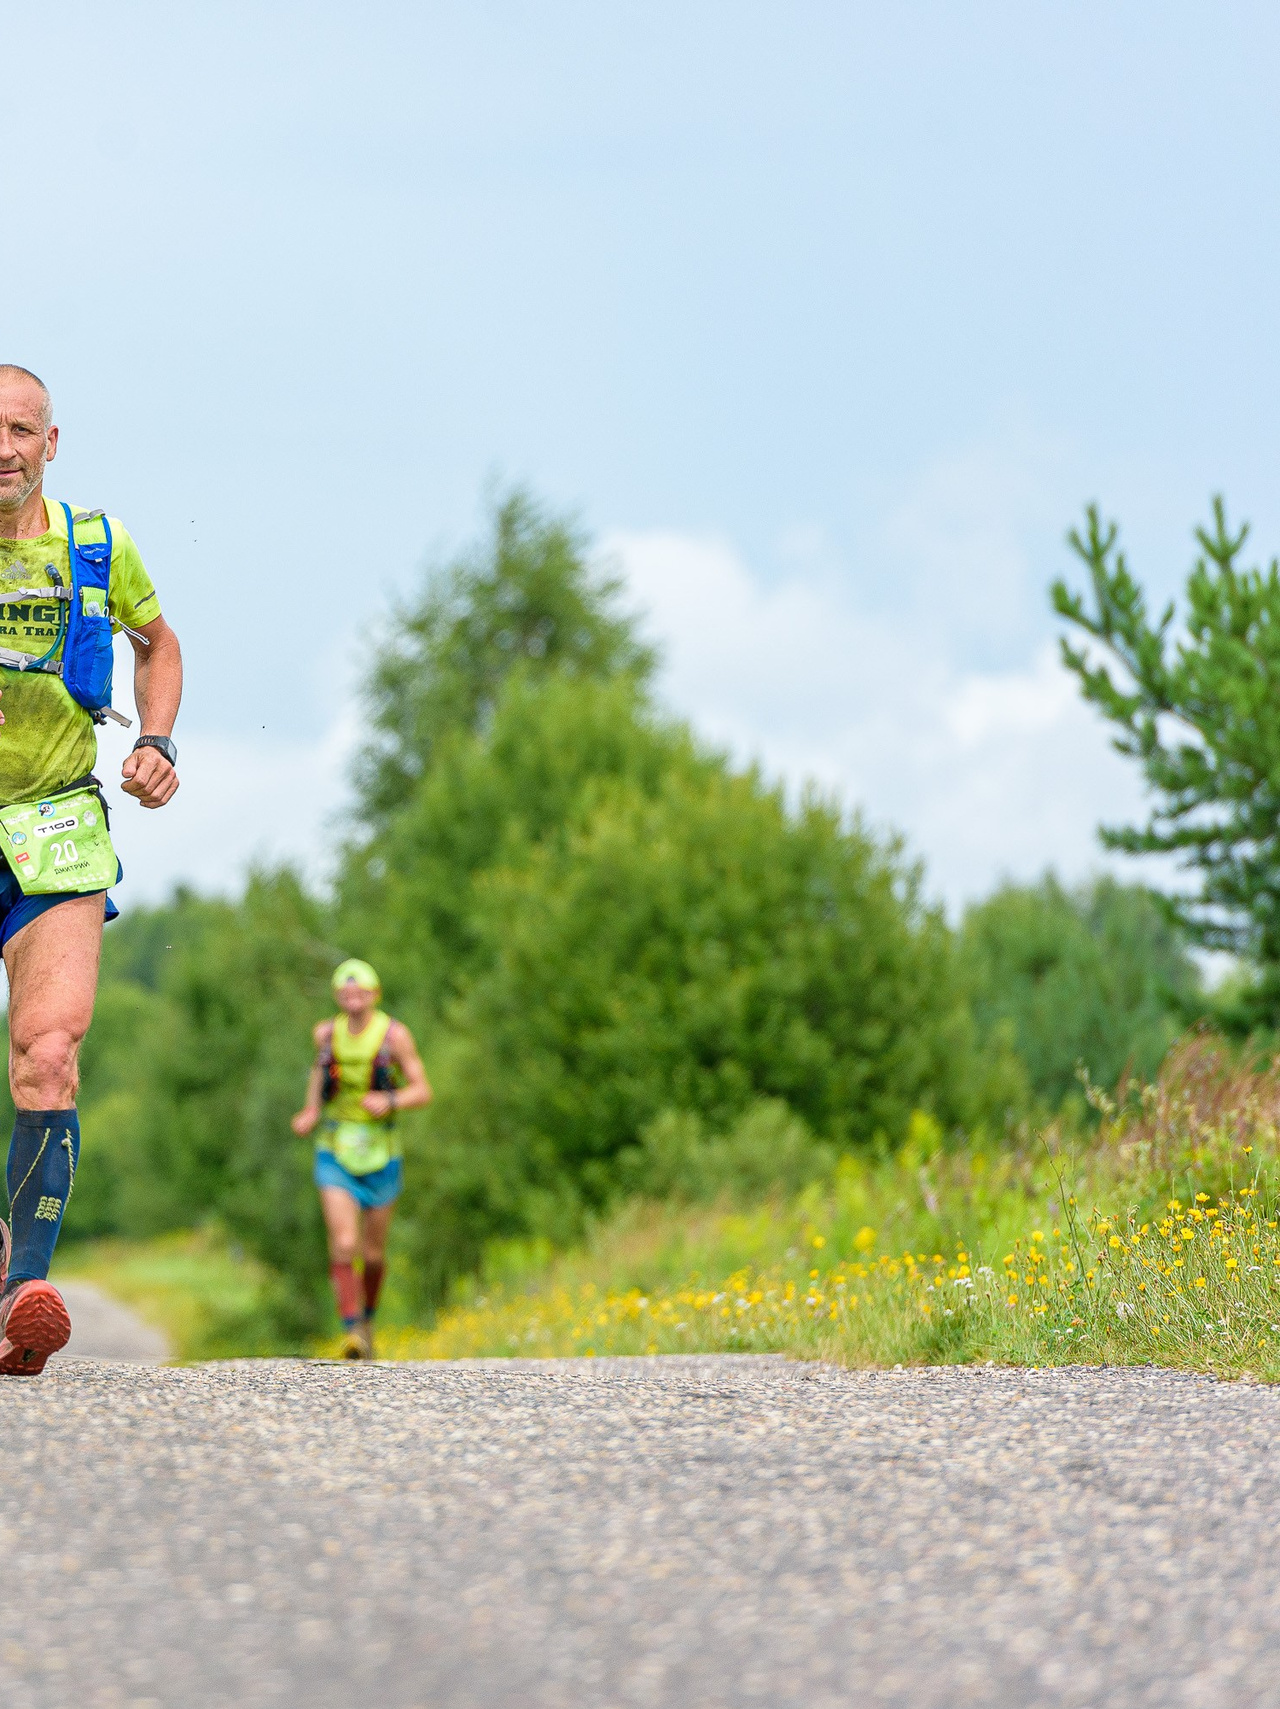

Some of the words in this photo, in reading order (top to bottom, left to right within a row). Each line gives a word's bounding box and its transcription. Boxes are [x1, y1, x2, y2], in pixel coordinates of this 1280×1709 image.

[38, 820, 75, 833] T100
[49, 839, 79, 867] 20
[54, 860, 91, 875] ДМИТРИЙ
